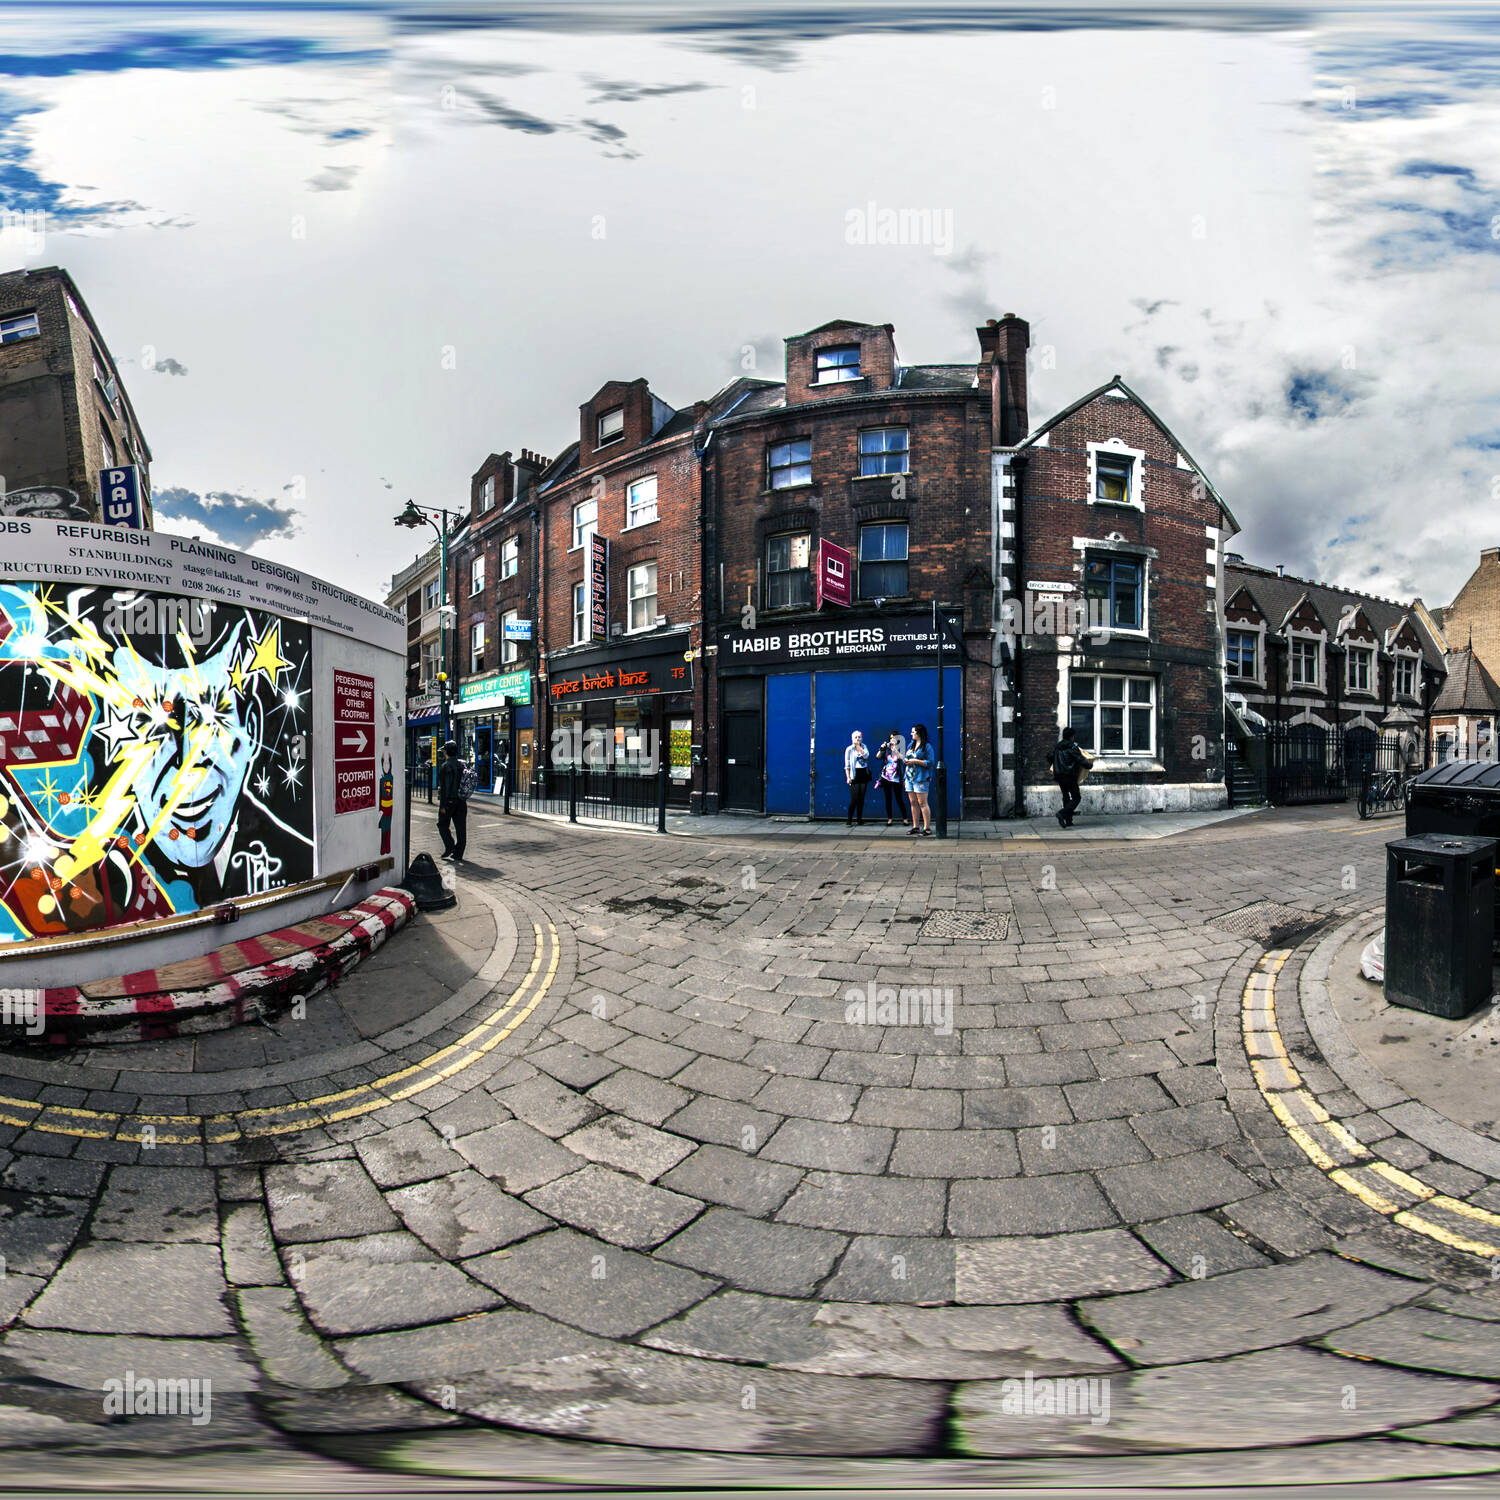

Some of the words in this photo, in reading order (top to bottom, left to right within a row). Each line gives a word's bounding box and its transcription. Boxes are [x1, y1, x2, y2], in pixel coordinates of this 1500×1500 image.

[57, 524, 151, 546] REFURBISH
[170, 540, 237, 565] PLANNING
[251, 560, 300, 584] DESIGIGN
[311, 581, 358, 607] STRUCTURE
[358, 599, 405, 627] CALCULATIONS
[69, 547, 173, 568] STANBUILDINGS
[183, 564, 259, 588] stasg@talktalk.net
[292, 590, 304, 601] 055
[304, 593, 318, 606] 3297
[86, 567, 171, 585] ENVIROMENT
[182, 579, 204, 590] 0208
[205, 583, 225, 595] 2066
[227, 586, 241, 598] 215
[732, 636, 781, 654] HABIB
[788, 628, 884, 649] BROTHERS
[889, 633, 927, 642] (TEXTILES
[929, 633, 946, 642] LT)
[789, 647, 830, 658] TEXTILES
[836, 643, 887, 655] MERCHANT
[335, 674, 374, 690] PEDESTRIANS
[485, 679, 498, 691] GIFT
[500, 673, 524, 688] CENTRE
[583, 670, 615, 690] brick
[337, 685, 360, 698] PLEASE
[361, 690, 372, 699] USE
[346, 698, 365, 709] OTHER
[340, 708, 370, 720] FOOTPATH
[337, 770, 374, 783] FOOTPATH
[341, 785, 371, 799] CLOSED
